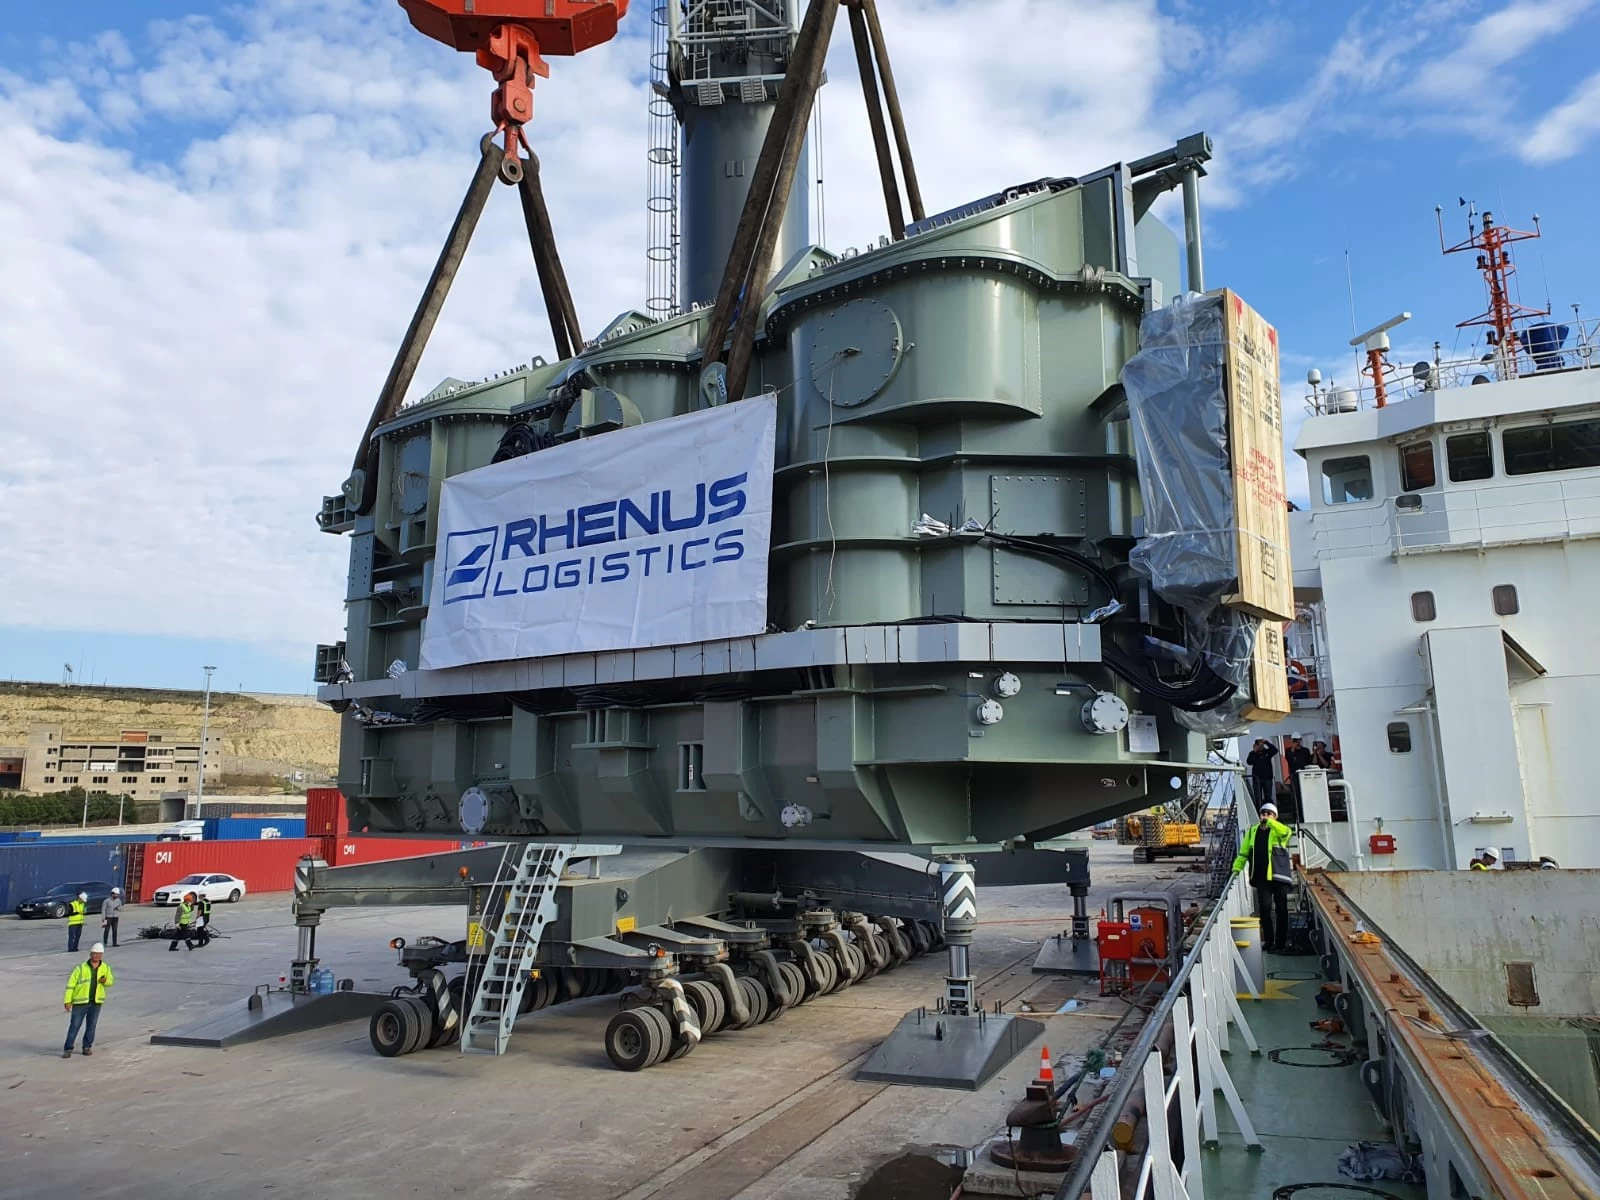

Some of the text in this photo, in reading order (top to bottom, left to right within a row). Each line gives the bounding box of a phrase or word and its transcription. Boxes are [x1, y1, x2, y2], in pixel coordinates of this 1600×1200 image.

[501, 472, 748, 561] RHENUS
[493, 529, 744, 597] LOGISTICS
[155, 851, 172, 864] CAI
